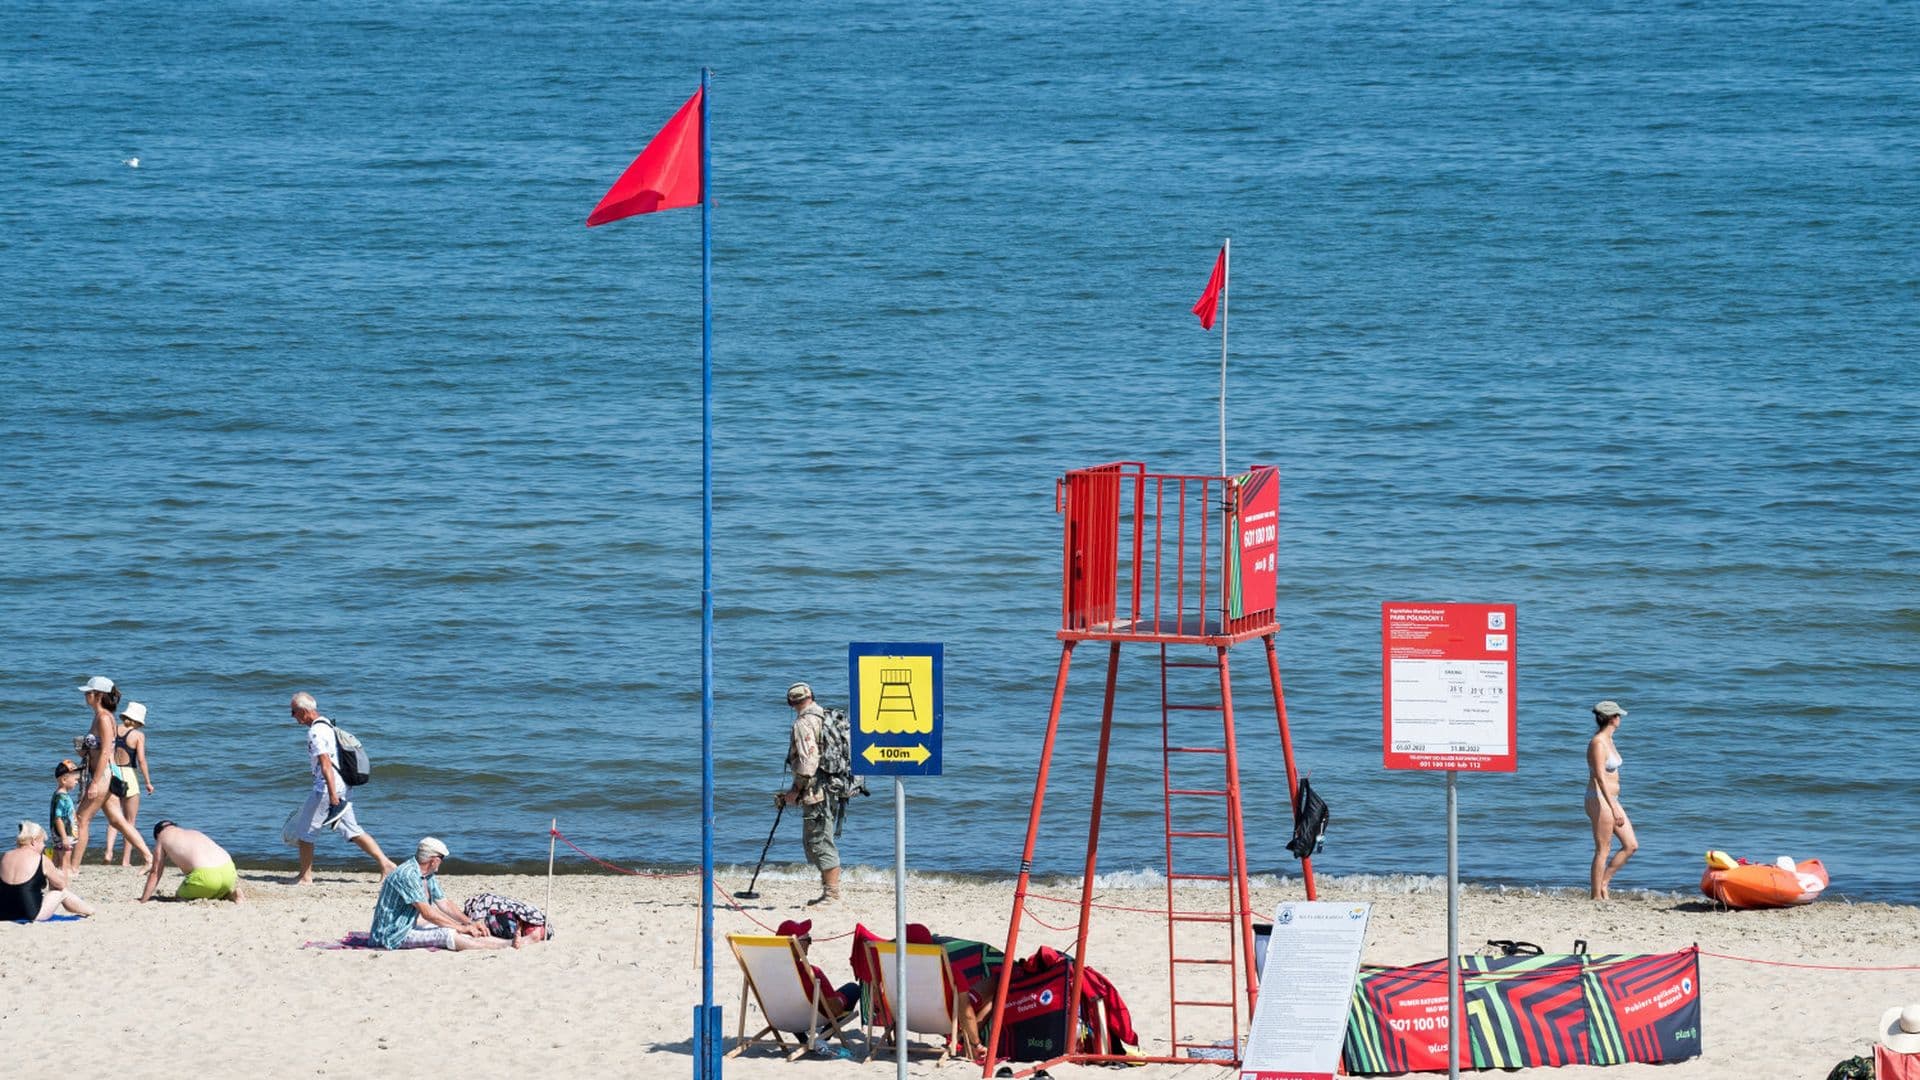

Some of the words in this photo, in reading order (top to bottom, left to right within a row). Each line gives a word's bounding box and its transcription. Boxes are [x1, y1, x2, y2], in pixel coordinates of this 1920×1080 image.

[1244, 530, 1255, 548] 601
[1255, 527, 1265, 545] 100
[1266, 524, 1275, 542] 100
[880, 749, 910, 758] 100m
[1624, 999, 1653, 1014] Pobierz
[1413, 1017, 1434, 1031] 100
[1435, 1016, 1449, 1029] 10
[1675, 1030, 1690, 1040] plus
[1028, 1038, 1043, 1048] plus
[1428, 1043, 1448, 1054] plus
